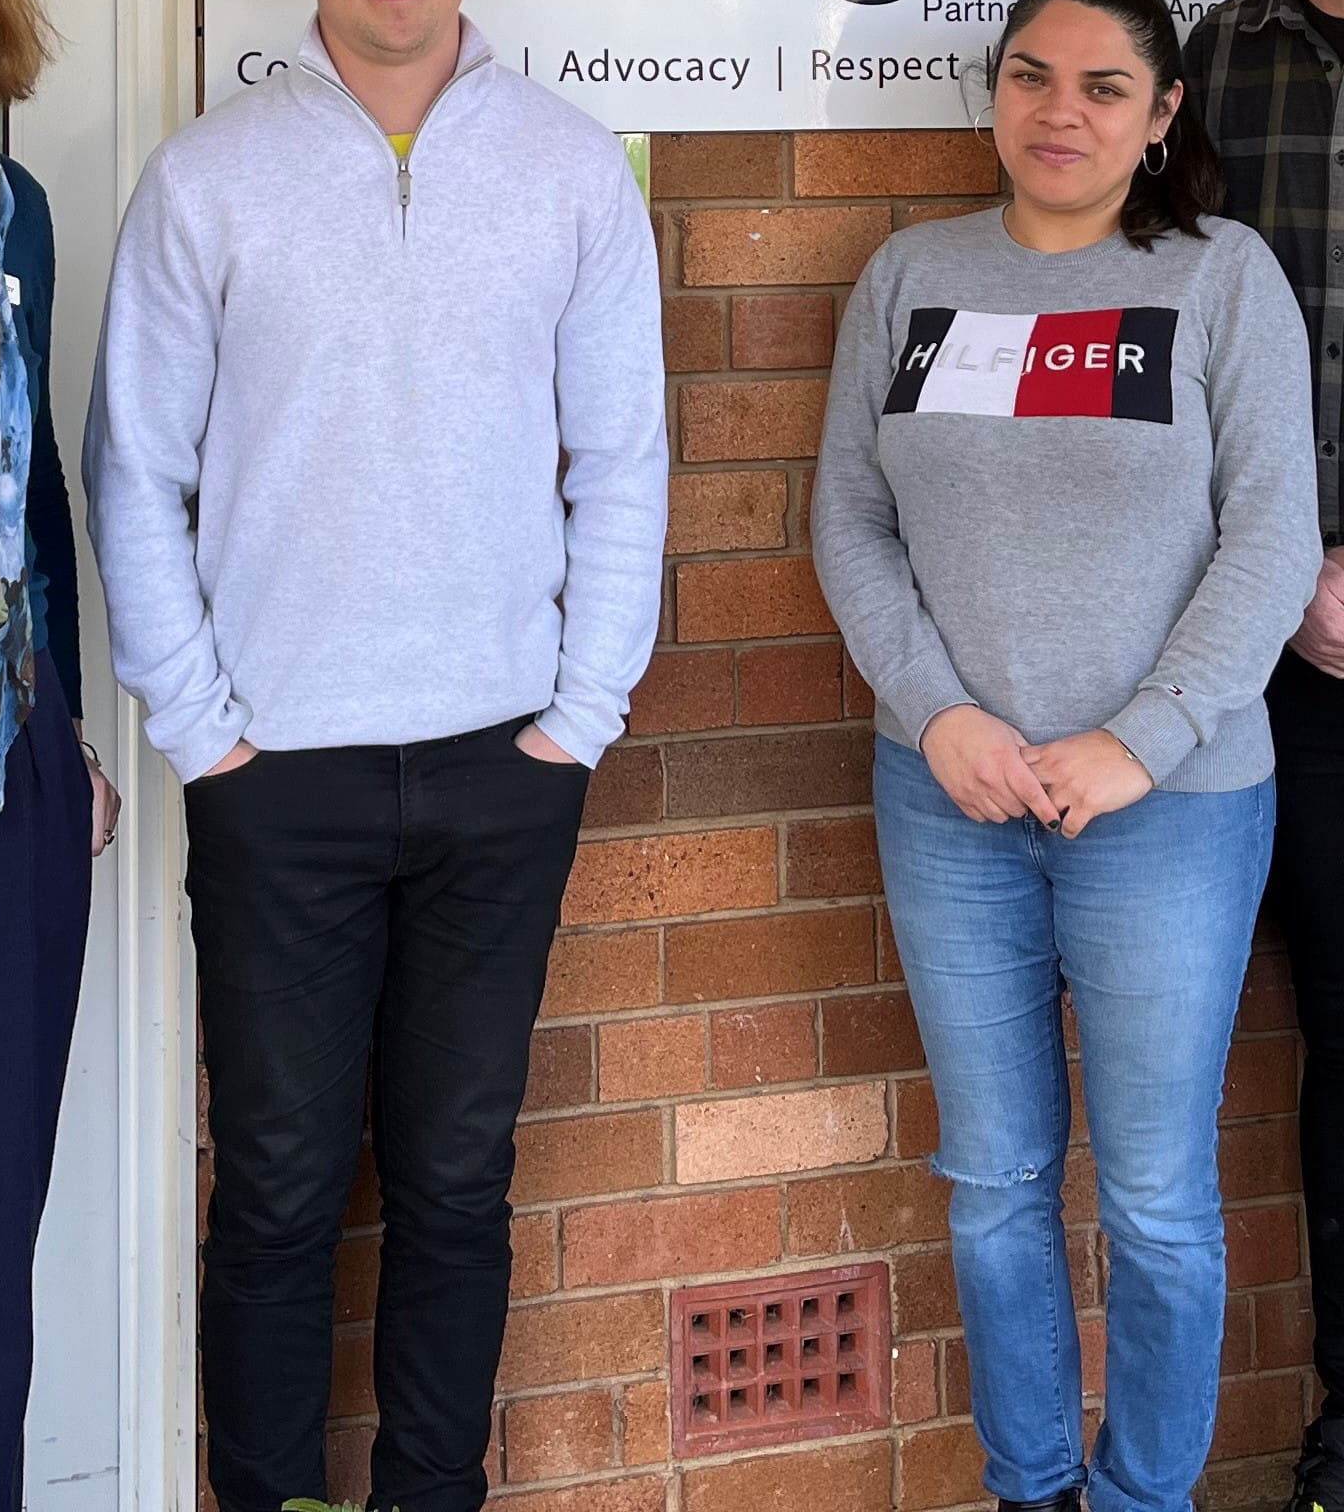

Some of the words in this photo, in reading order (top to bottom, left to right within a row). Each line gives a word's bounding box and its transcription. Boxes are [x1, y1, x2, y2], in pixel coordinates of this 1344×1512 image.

[558, 48, 750, 90] Advocacy
[811, 48, 960, 88] Respect
[906, 342, 1146, 375] HILFIGER
